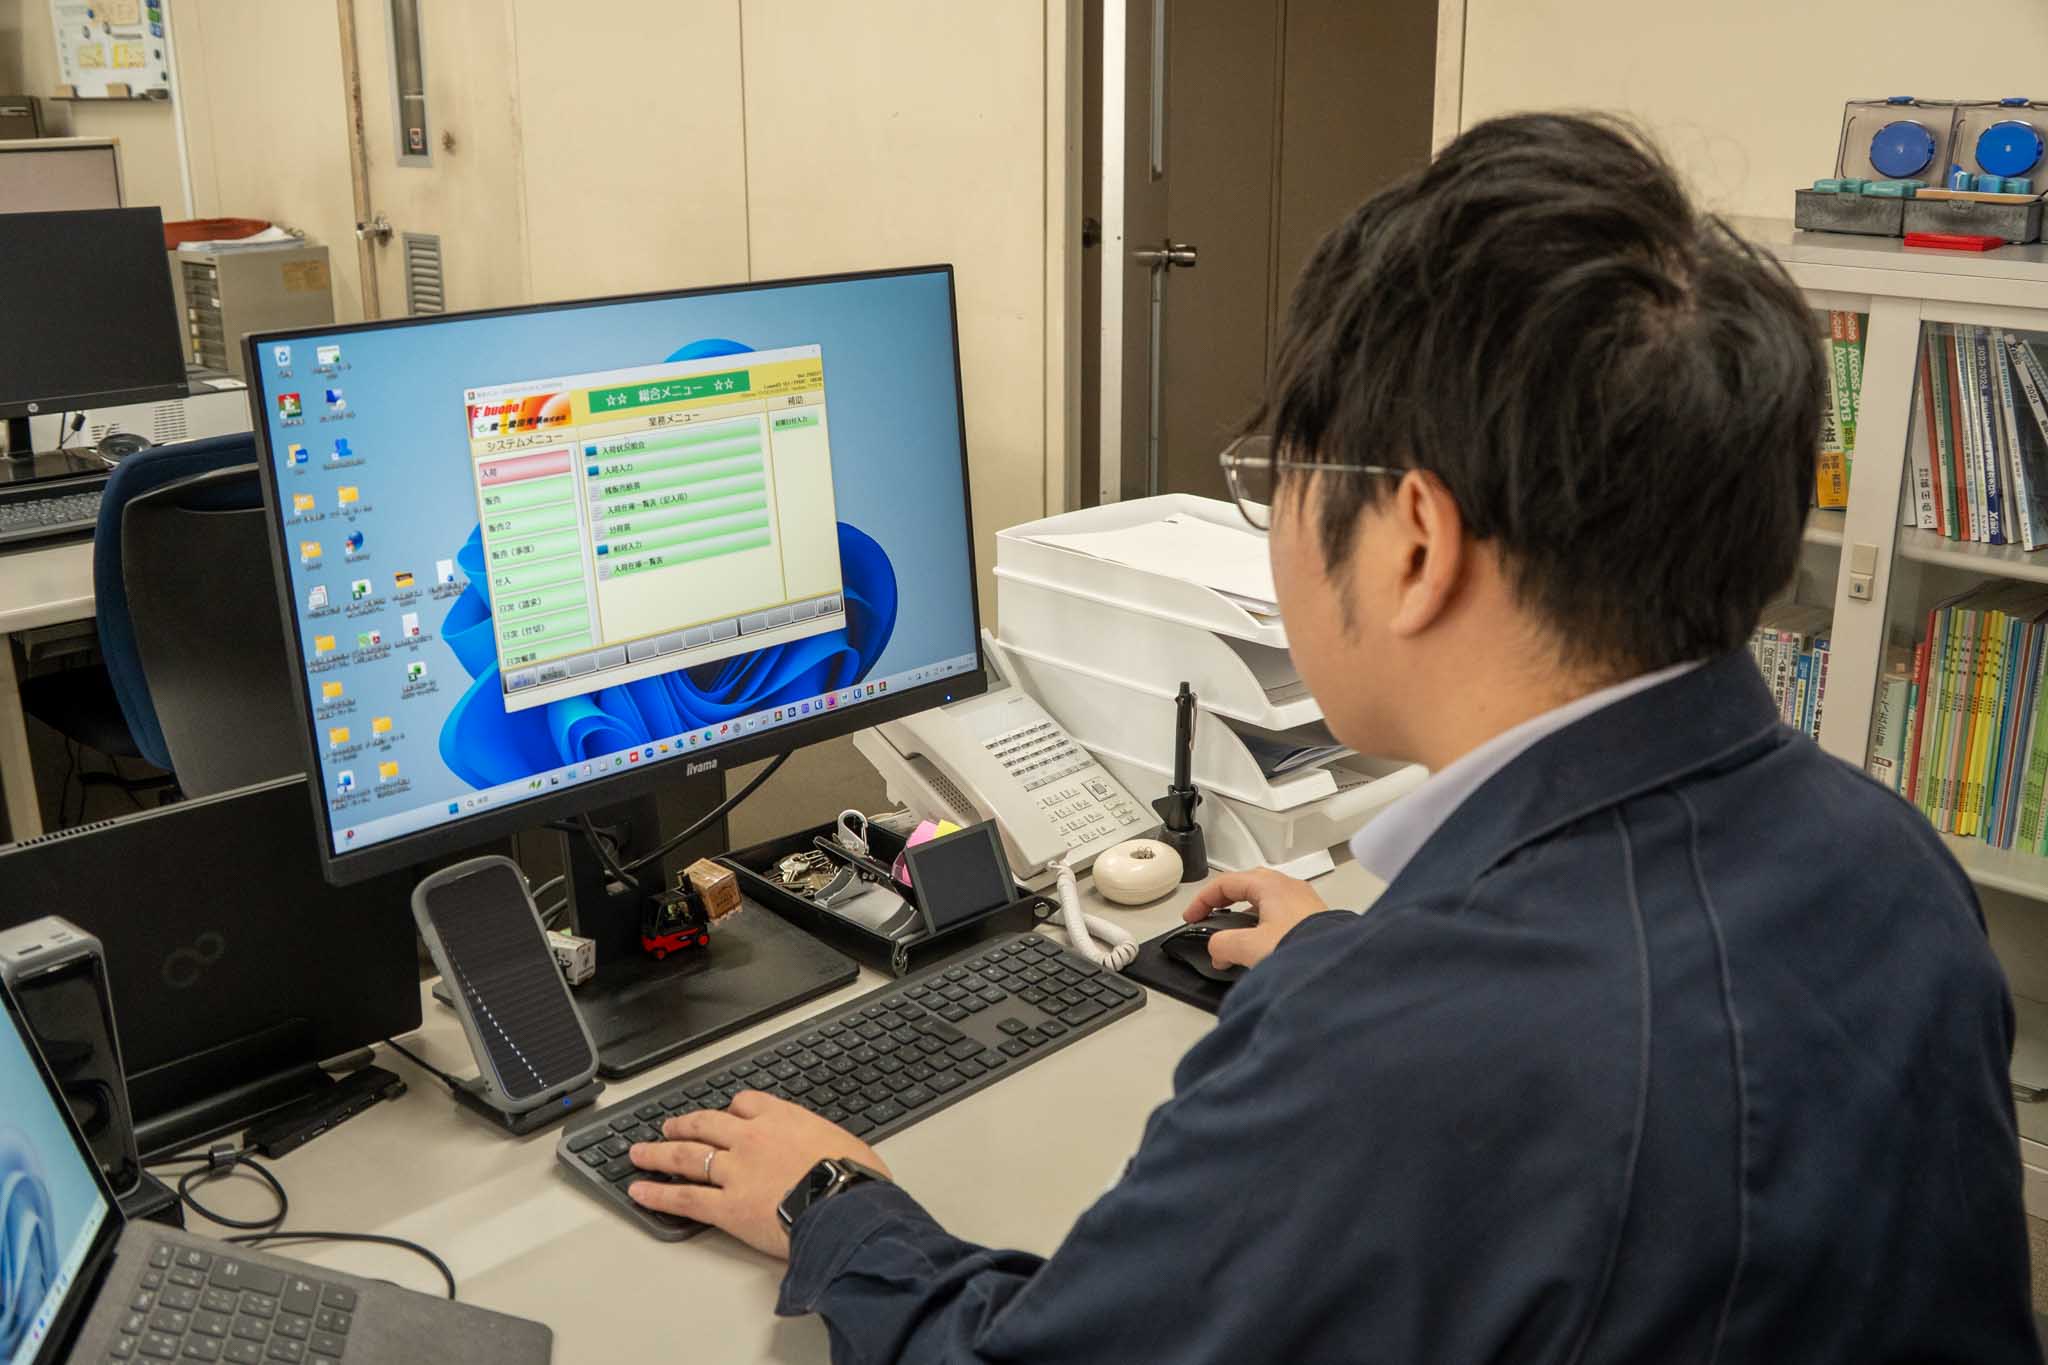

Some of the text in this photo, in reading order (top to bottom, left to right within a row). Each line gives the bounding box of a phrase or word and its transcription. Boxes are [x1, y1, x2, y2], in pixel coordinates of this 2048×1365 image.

[1834, 347, 1847, 389] Access
[638, 384, 703, 402] 総合メニュー
[2025, 383, 2039, 404] 2024
[1838, 390, 1852, 422] 2013
[487, 434, 564, 452] システムメニュー
[686, 758, 718, 777] iiyama
